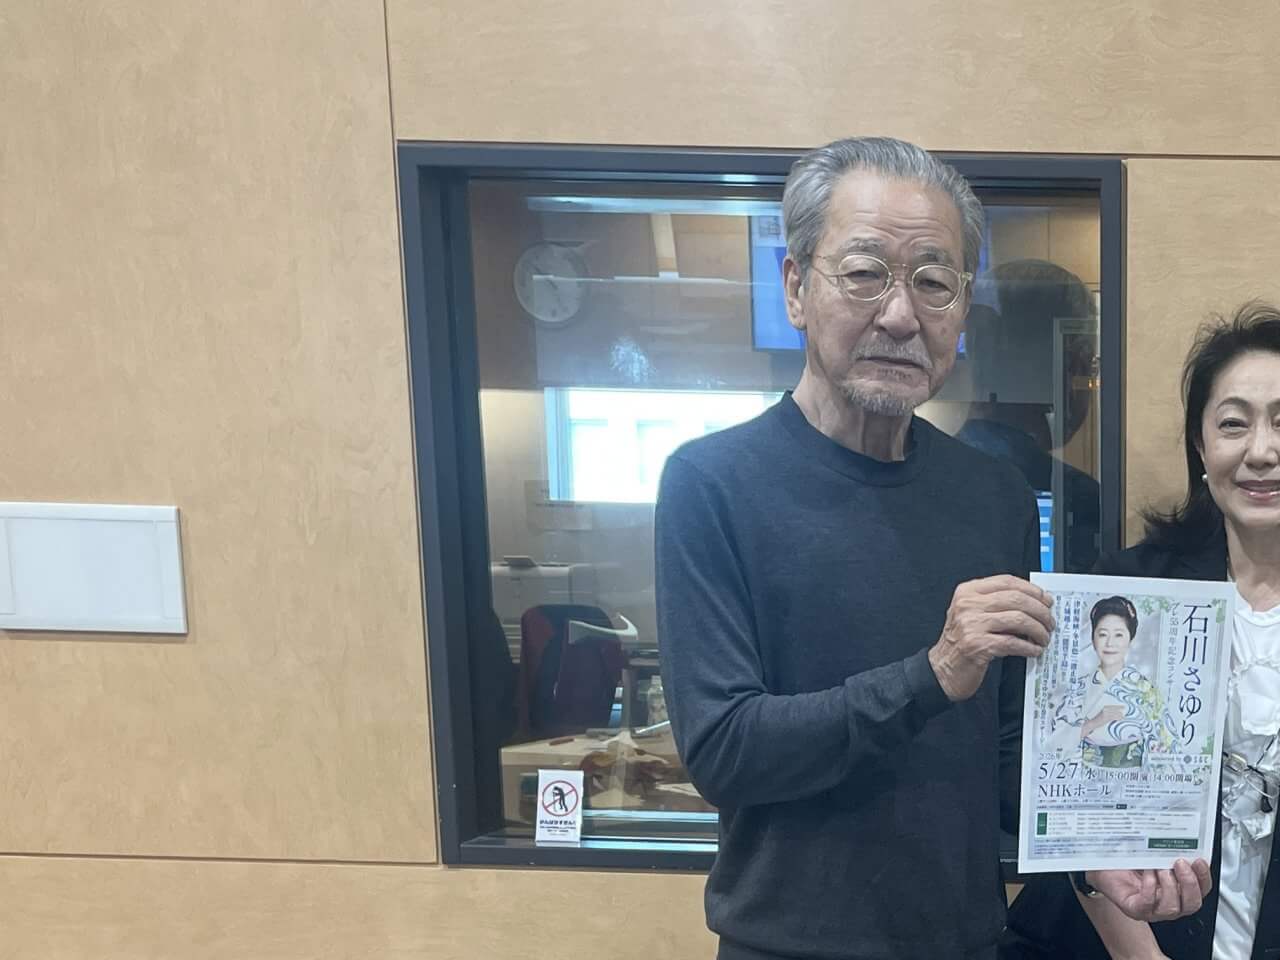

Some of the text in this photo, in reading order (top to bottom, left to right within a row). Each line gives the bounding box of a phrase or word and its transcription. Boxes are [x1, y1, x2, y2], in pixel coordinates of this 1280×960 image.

[1179, 604, 1213, 745] 石川さゆり
[1037, 761, 1079, 780] 5/27
[1037, 783, 1112, 798] NHKホール
